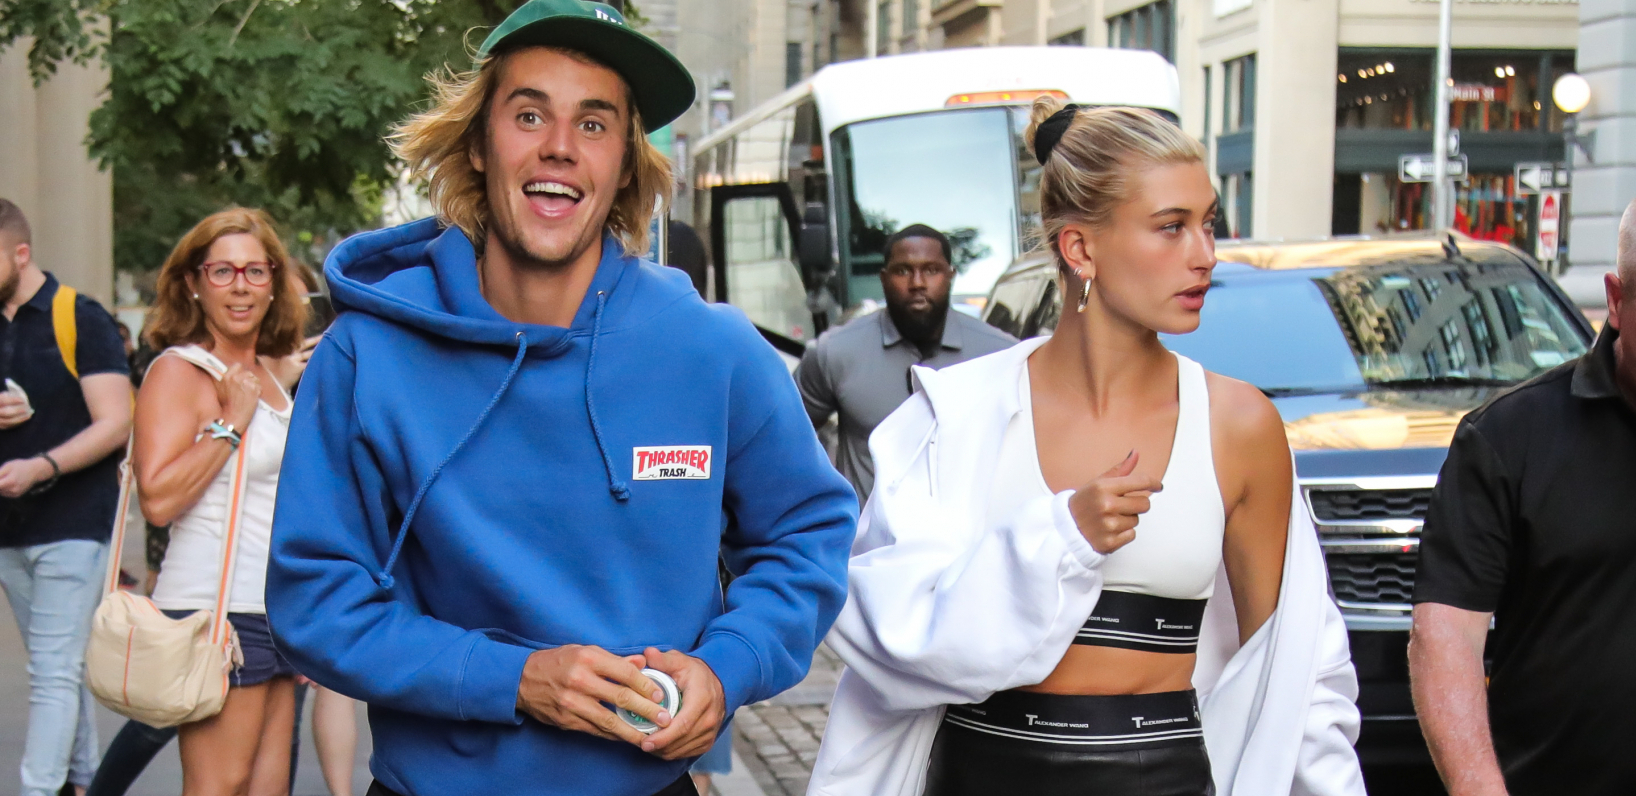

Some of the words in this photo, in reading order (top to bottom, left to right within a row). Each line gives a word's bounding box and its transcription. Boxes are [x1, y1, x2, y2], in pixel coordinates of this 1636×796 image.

[1453, 86, 1480, 100] Main
[1483, 87, 1495, 101] St
[636, 450, 709, 474] THRASHER
[659, 468, 687, 477] TRASH
